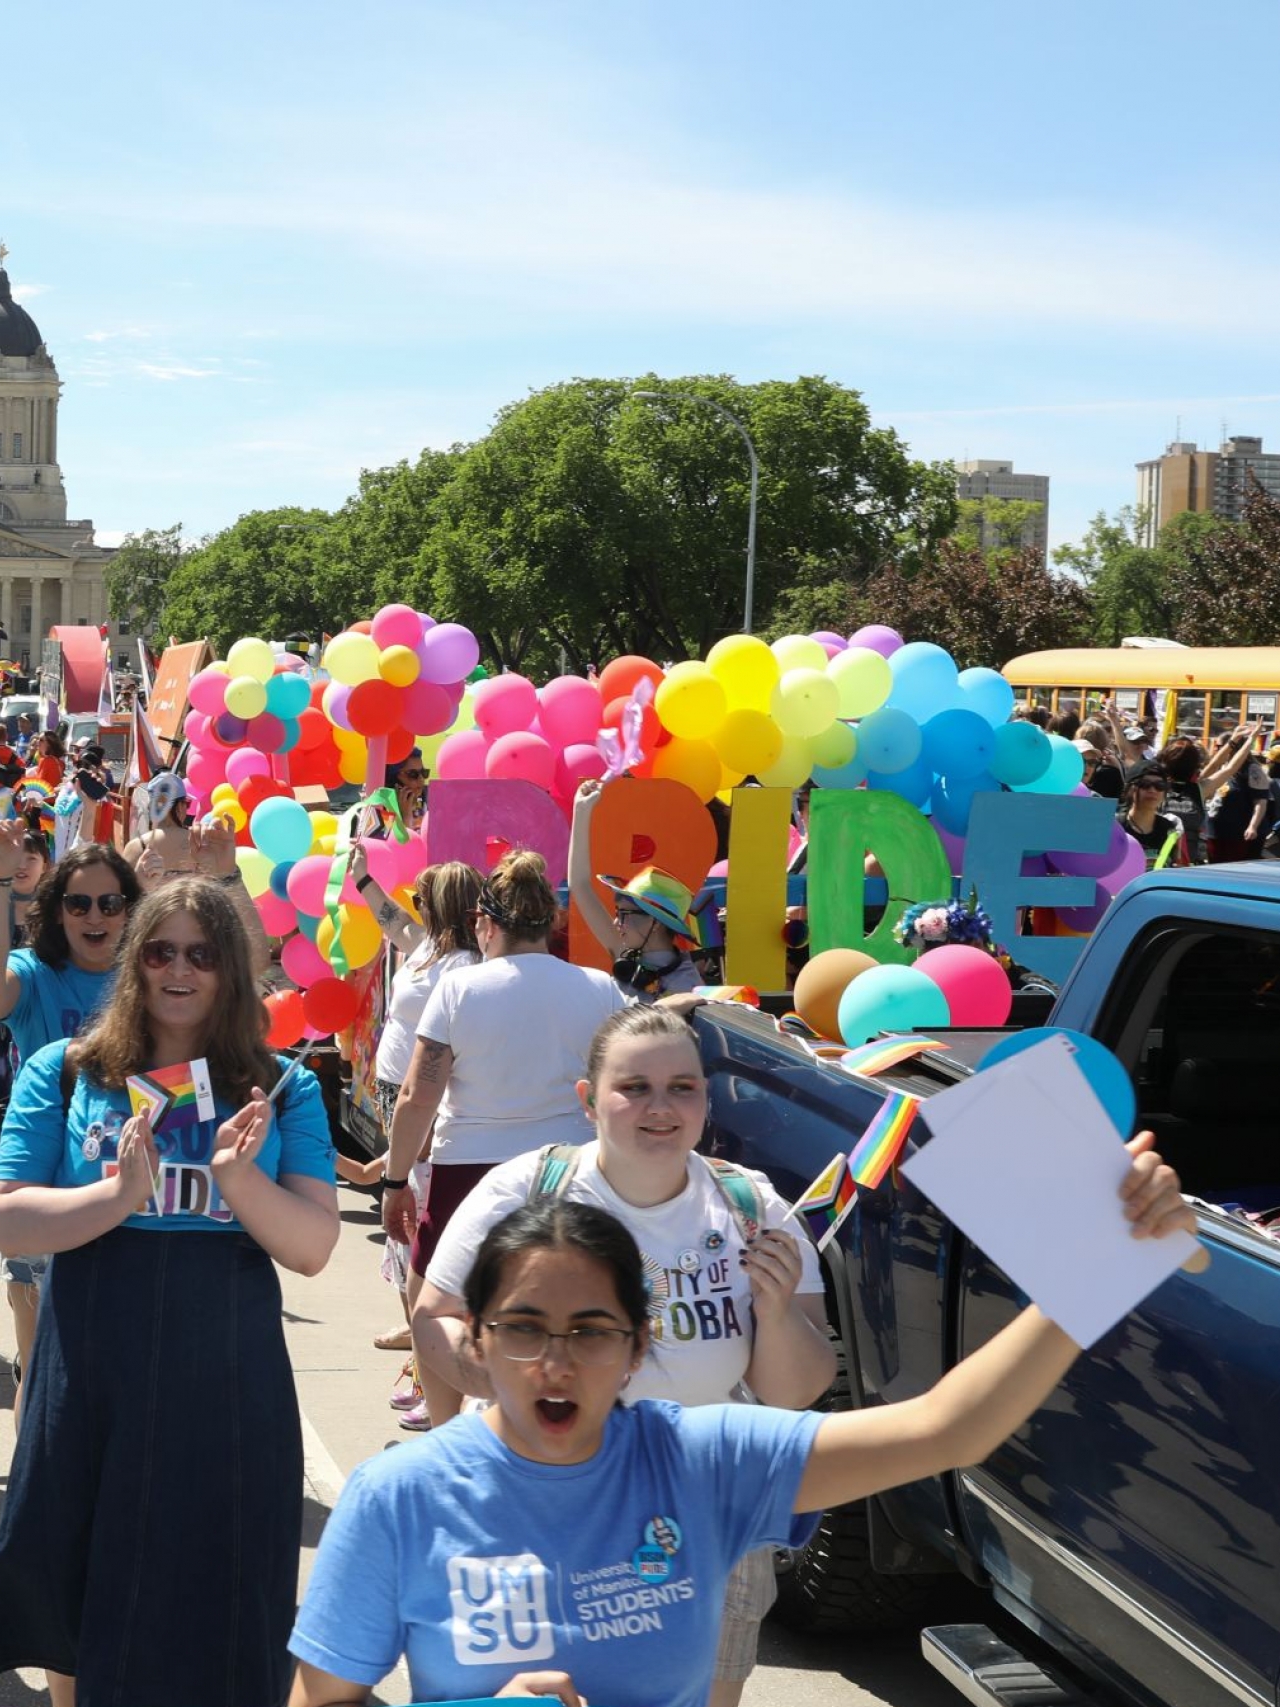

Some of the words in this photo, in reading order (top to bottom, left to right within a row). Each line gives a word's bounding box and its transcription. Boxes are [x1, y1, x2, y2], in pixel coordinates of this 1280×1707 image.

[427, 777, 1118, 991] PRIDE
[708, 1258, 729, 1284] OF
[573, 1586, 588, 1600] of
[582, 1611, 663, 1641] UNION
